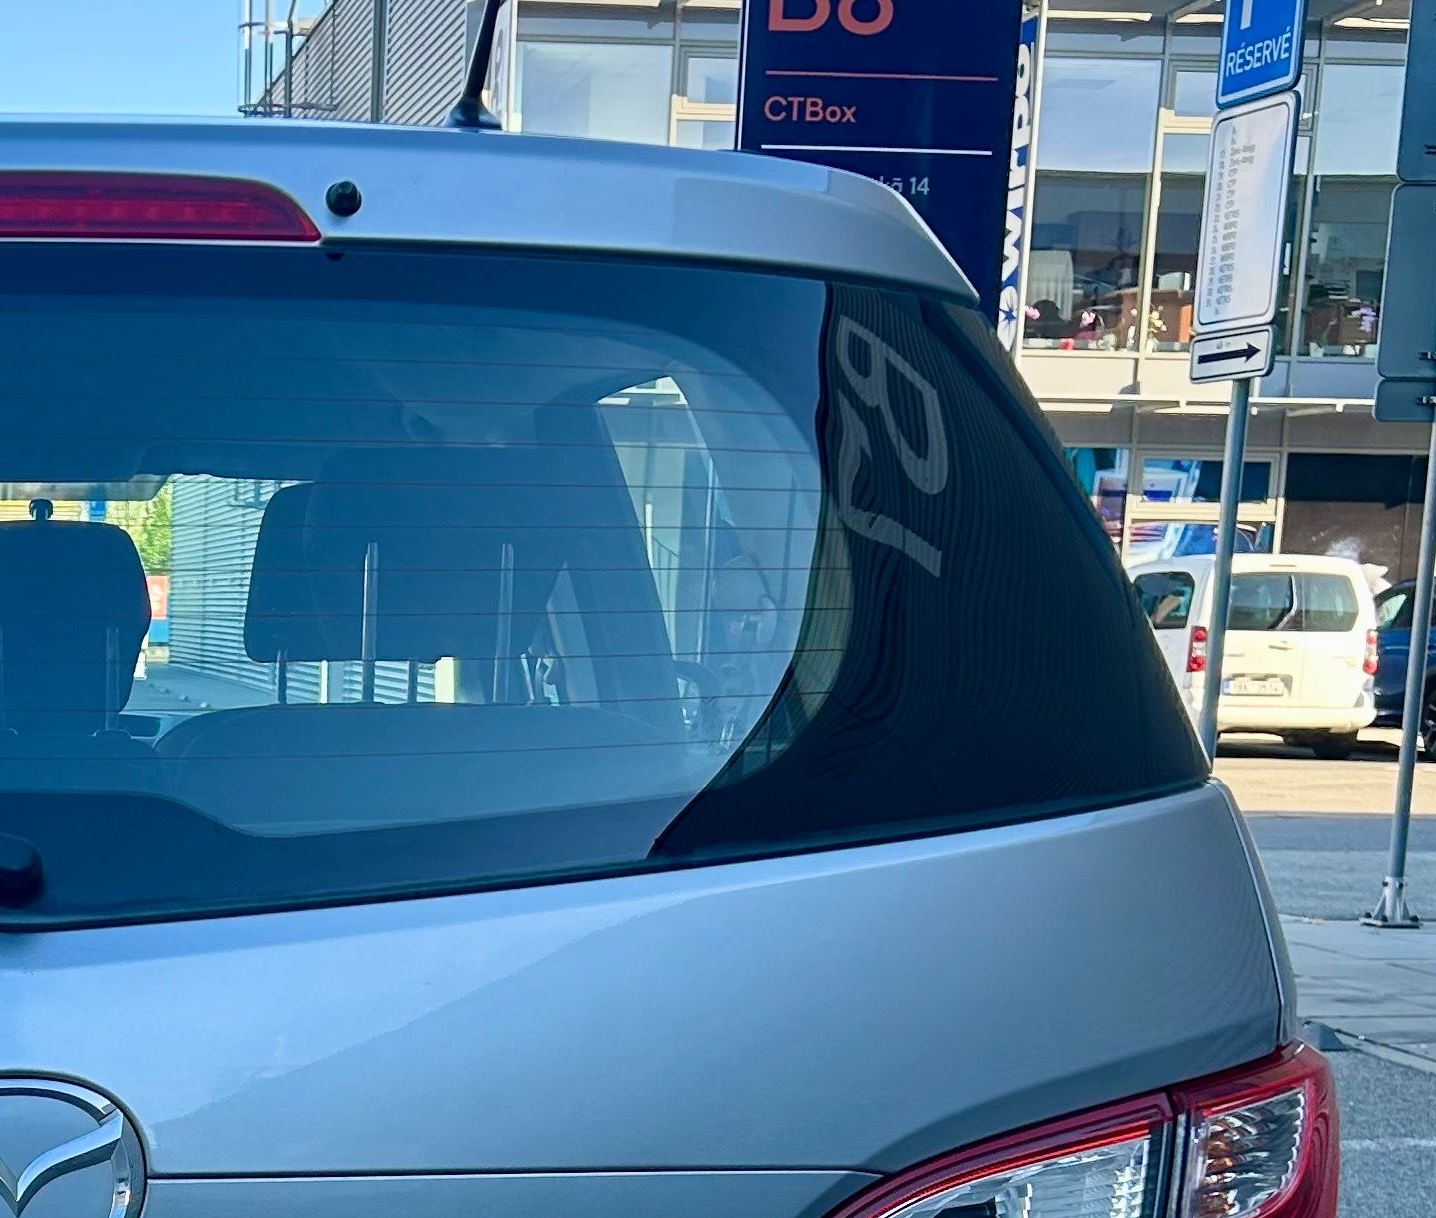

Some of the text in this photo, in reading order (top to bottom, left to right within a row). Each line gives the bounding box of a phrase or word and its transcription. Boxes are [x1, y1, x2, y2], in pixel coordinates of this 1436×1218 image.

[1225, 25, 1292, 78] RÉSERVÉ
[764, 95, 857, 123] CTBox
[909, 176, 930, 195] 14
